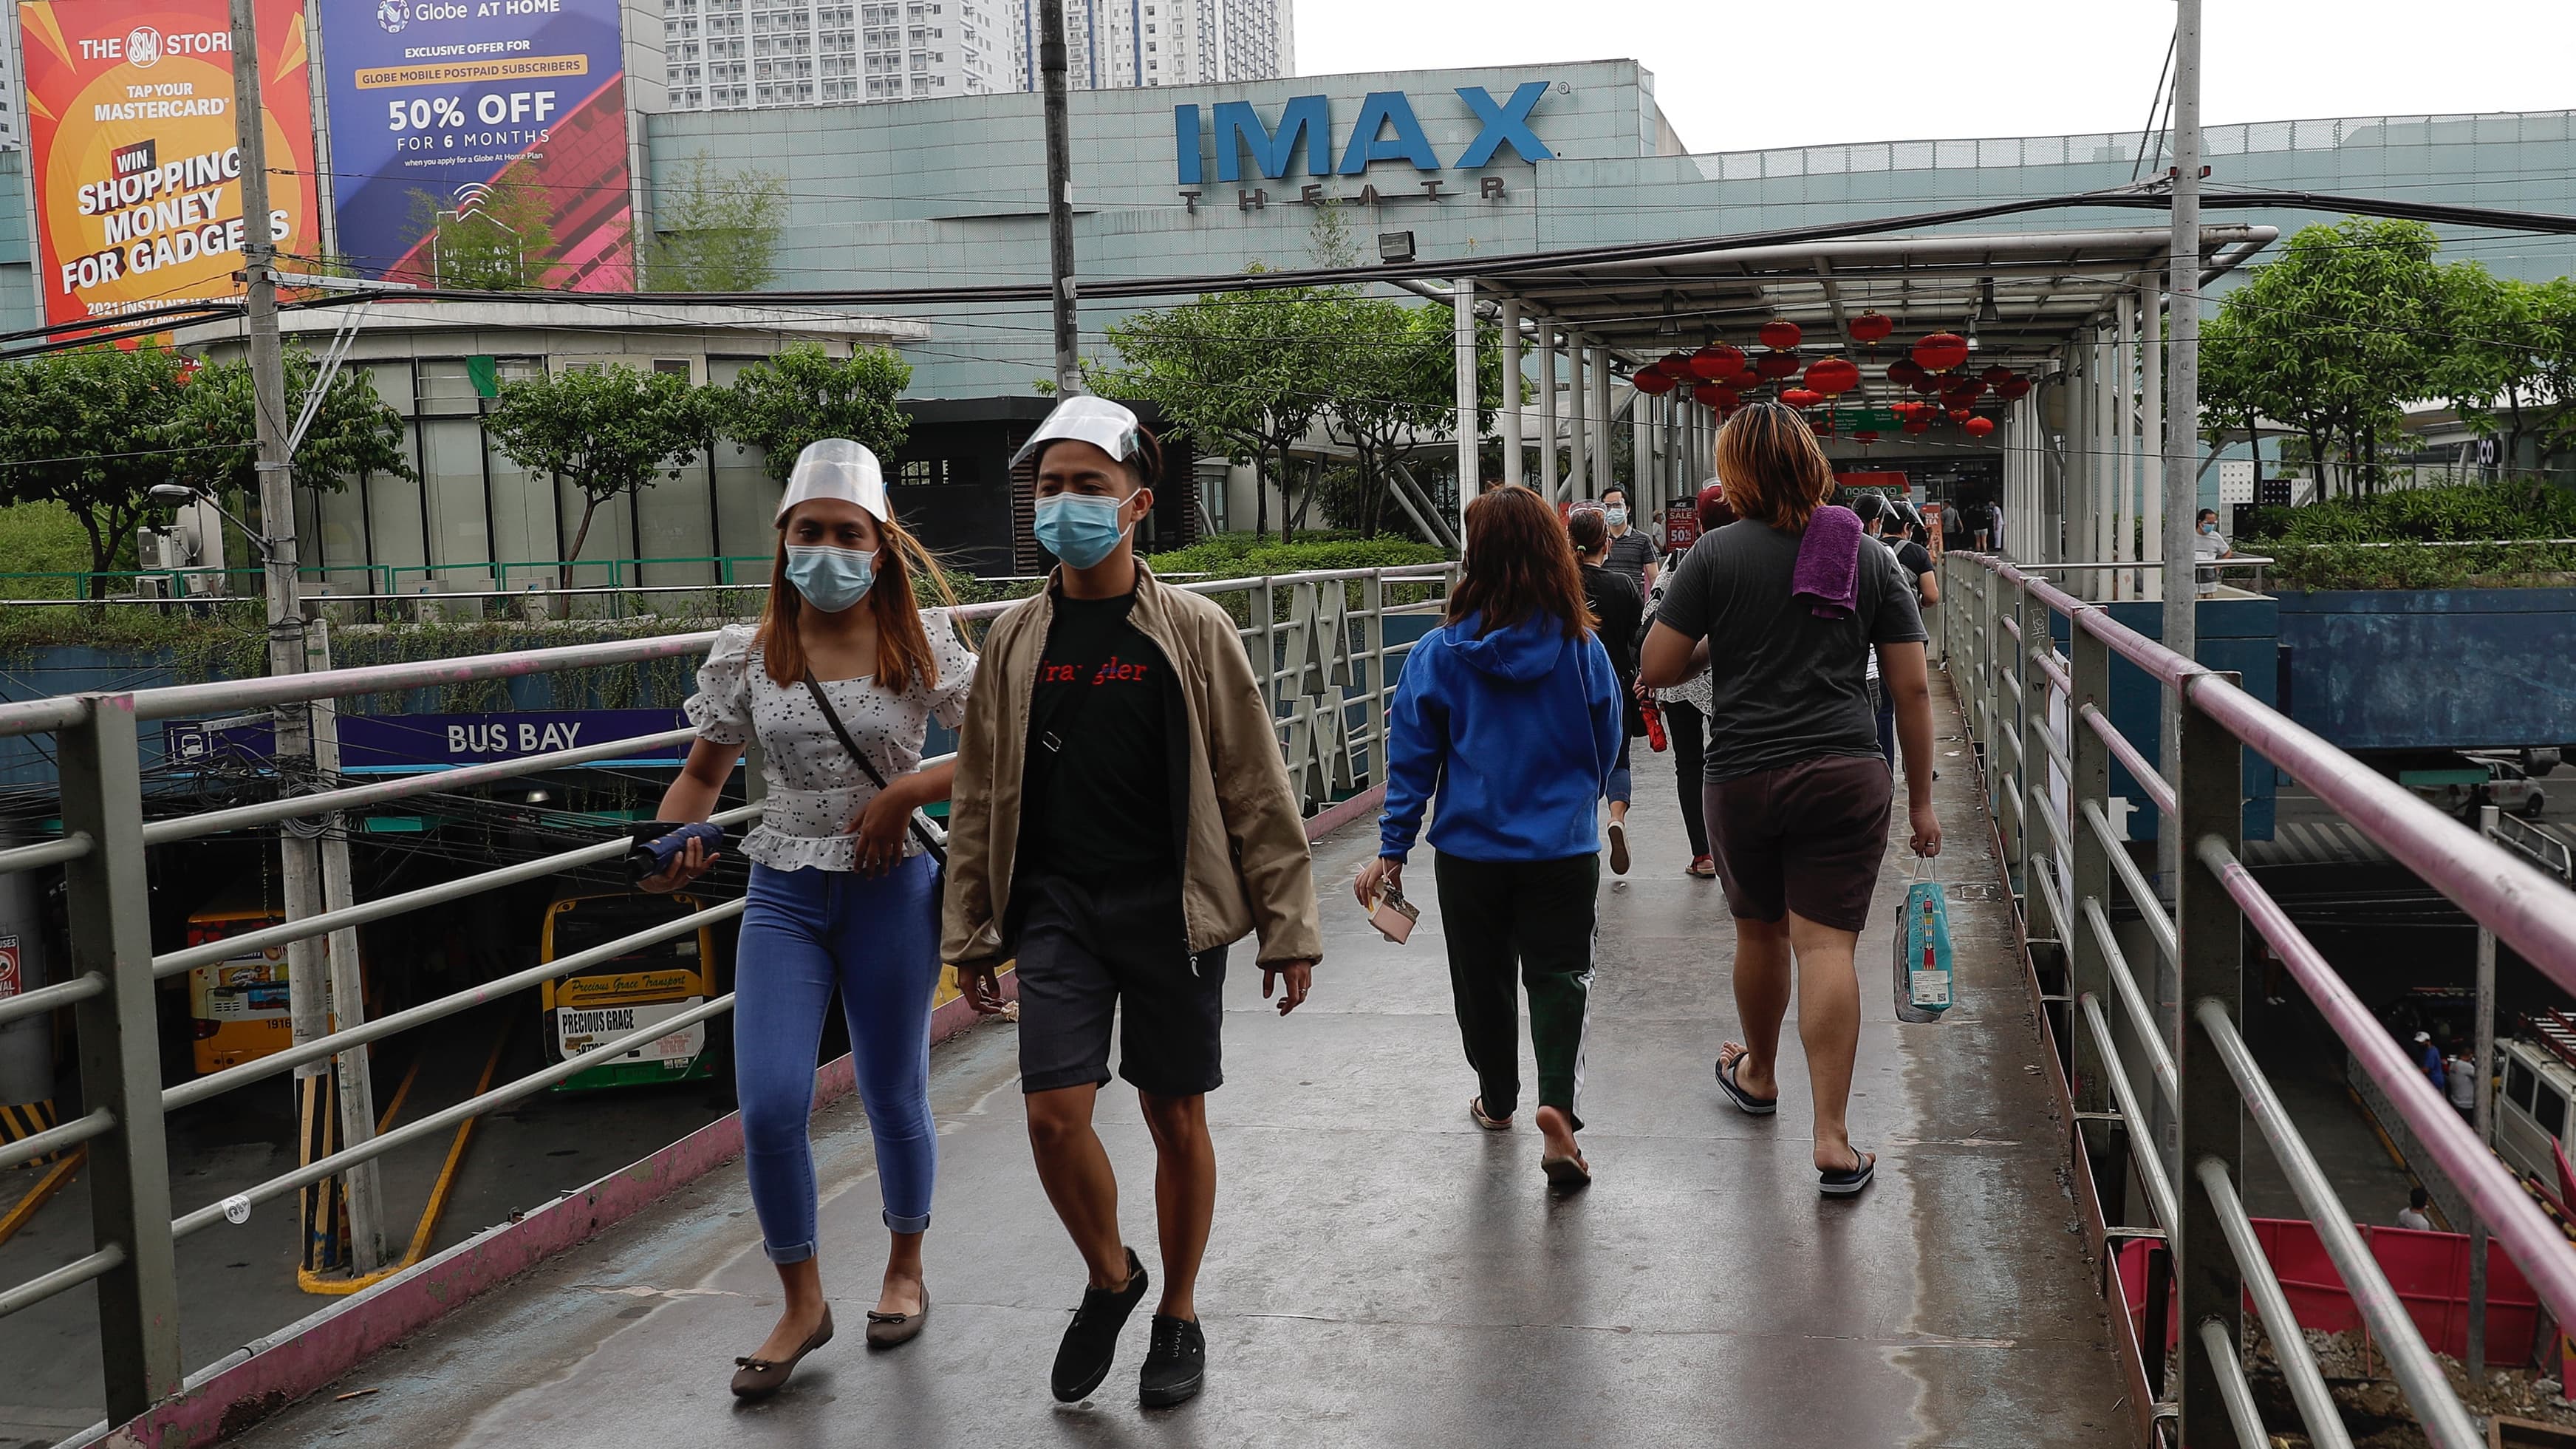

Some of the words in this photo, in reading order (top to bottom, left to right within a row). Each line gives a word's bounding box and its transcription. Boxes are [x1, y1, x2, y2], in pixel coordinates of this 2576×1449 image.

[415, 3, 468, 21] Globe
[477, 2, 501, 17] AT
[506, 0, 560, 15] HOME
[79, 38, 121, 60] THE
[167, 31, 233, 55] STOR
[405, 44, 465, 58] EXCLUSIVE
[468, 42, 504, 55] OFFER
[507, 40, 530, 52] FOR
[362, 73, 397, 84] GLOBE
[400, 70, 441, 81] MOBILE
[445, 67, 499, 79] POSTPAID
[502, 60, 581, 75] SUBSCRIBERS
[126, 84, 152, 98] TAP
[154, 82, 193, 96] YOUR
[389, 96, 465, 131] 50%
[477, 90, 556, 125] OFF
[397, 136, 434, 151] FOR
[444, 134, 454, 148] 6
[465, 129, 550, 147] MONTHS
[1175, 81, 1556, 184] IMAX
[116, 149, 148, 174] WIN
[404, 159, 423, 168] when
[423, 158, 437, 167] you
[437, 156, 456, 166] apply
[457, 155, 467, 163] for
[474, 154, 493, 162] Globe
[78, 146, 241, 216] SHOPPING
[1178, 176, 1506, 214] THEATR
[104, 187, 223, 246] MONEY
[61, 250, 120, 295] FOR
[129, 209, 290, 274] GADGES
[87, 301, 118, 316] 2021
[1039, 656, 1147, 686] ragler
[448, 722, 509, 753] BUS
[519, 721, 581, 752] BAY
[572, 979, 609, 994] Precious
[613, 977, 638, 993] Grace
[642, 974, 686, 988] Transport
[562, 1011, 605, 1034] PRECIOUS
[606, 1009, 634, 1031] GRACE
